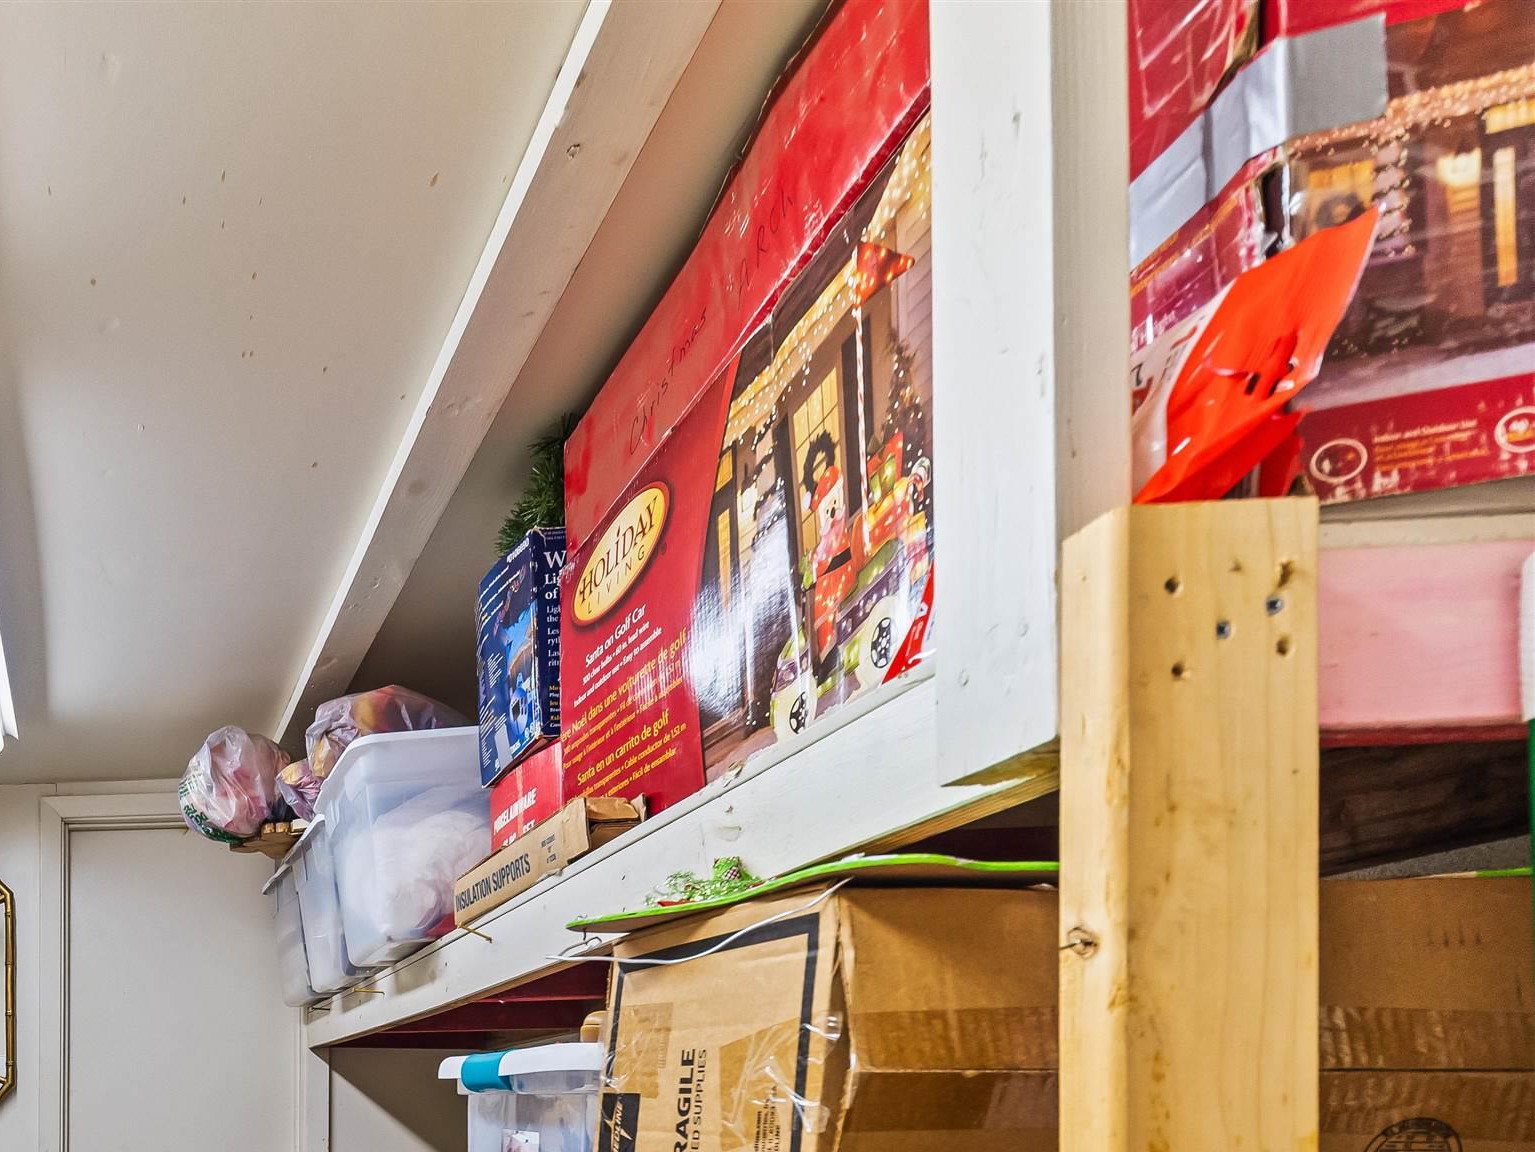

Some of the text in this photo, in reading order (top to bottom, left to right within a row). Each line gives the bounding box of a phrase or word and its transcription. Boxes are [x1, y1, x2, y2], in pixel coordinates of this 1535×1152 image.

[630, 306, 707, 456] Christmas
[579, 494, 658, 606] HOLIDAY
[544, 587, 559, 599] of
[585, 604, 646, 668] Santa on Golf Car
[571, 710, 588, 733] Noël
[587, 701, 604, 721] dans
[604, 689, 617, 708] une
[617, 658, 656, 697] voiturette
[657, 646, 667, 664] de
[669, 627, 687, 660] golf
[577, 708, 670, 786] Santa en un carrito de golf
[455, 852, 531, 913] INSULATION SUPPORTS
[693, 1049, 707, 1126] SUPPLIES
